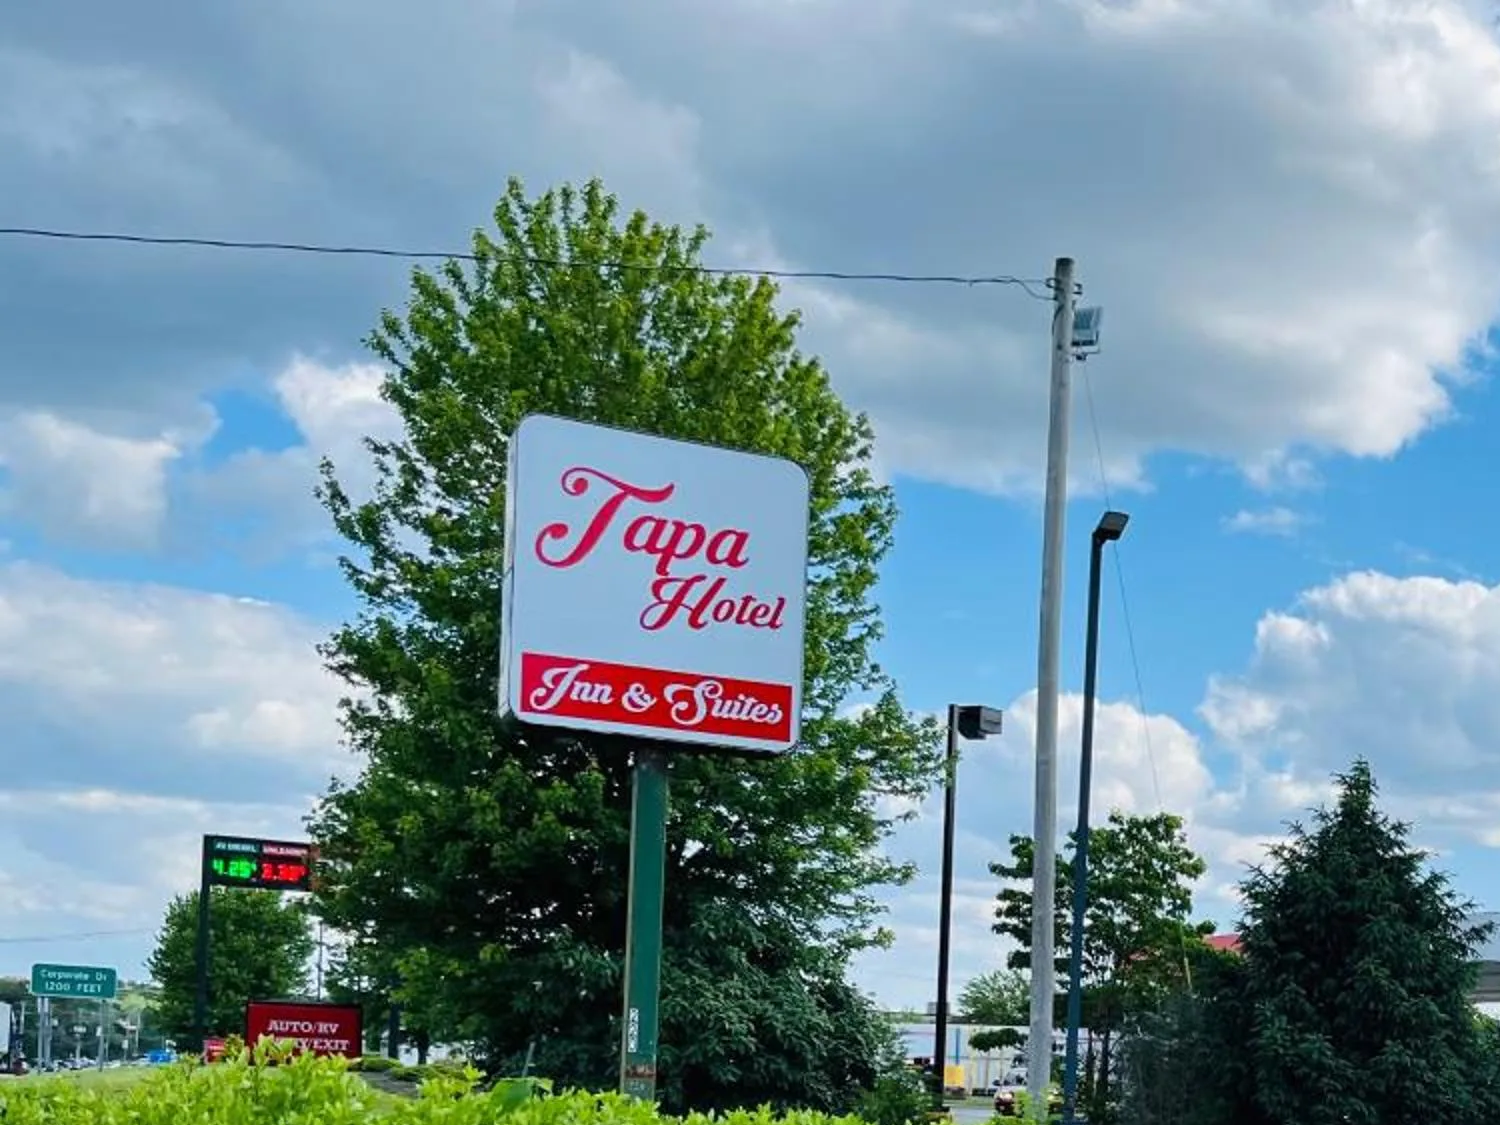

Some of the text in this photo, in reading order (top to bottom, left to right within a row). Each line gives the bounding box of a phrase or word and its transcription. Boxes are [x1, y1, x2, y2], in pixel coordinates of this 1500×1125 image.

[535, 467, 750, 576] Tapa
[640, 574, 787, 631] Hotel
[529, 664, 783, 725] Inn & Suites
[45, 981, 102, 993] 1200 FEET
[268, 1020, 340, 1034] AUTO/RV
